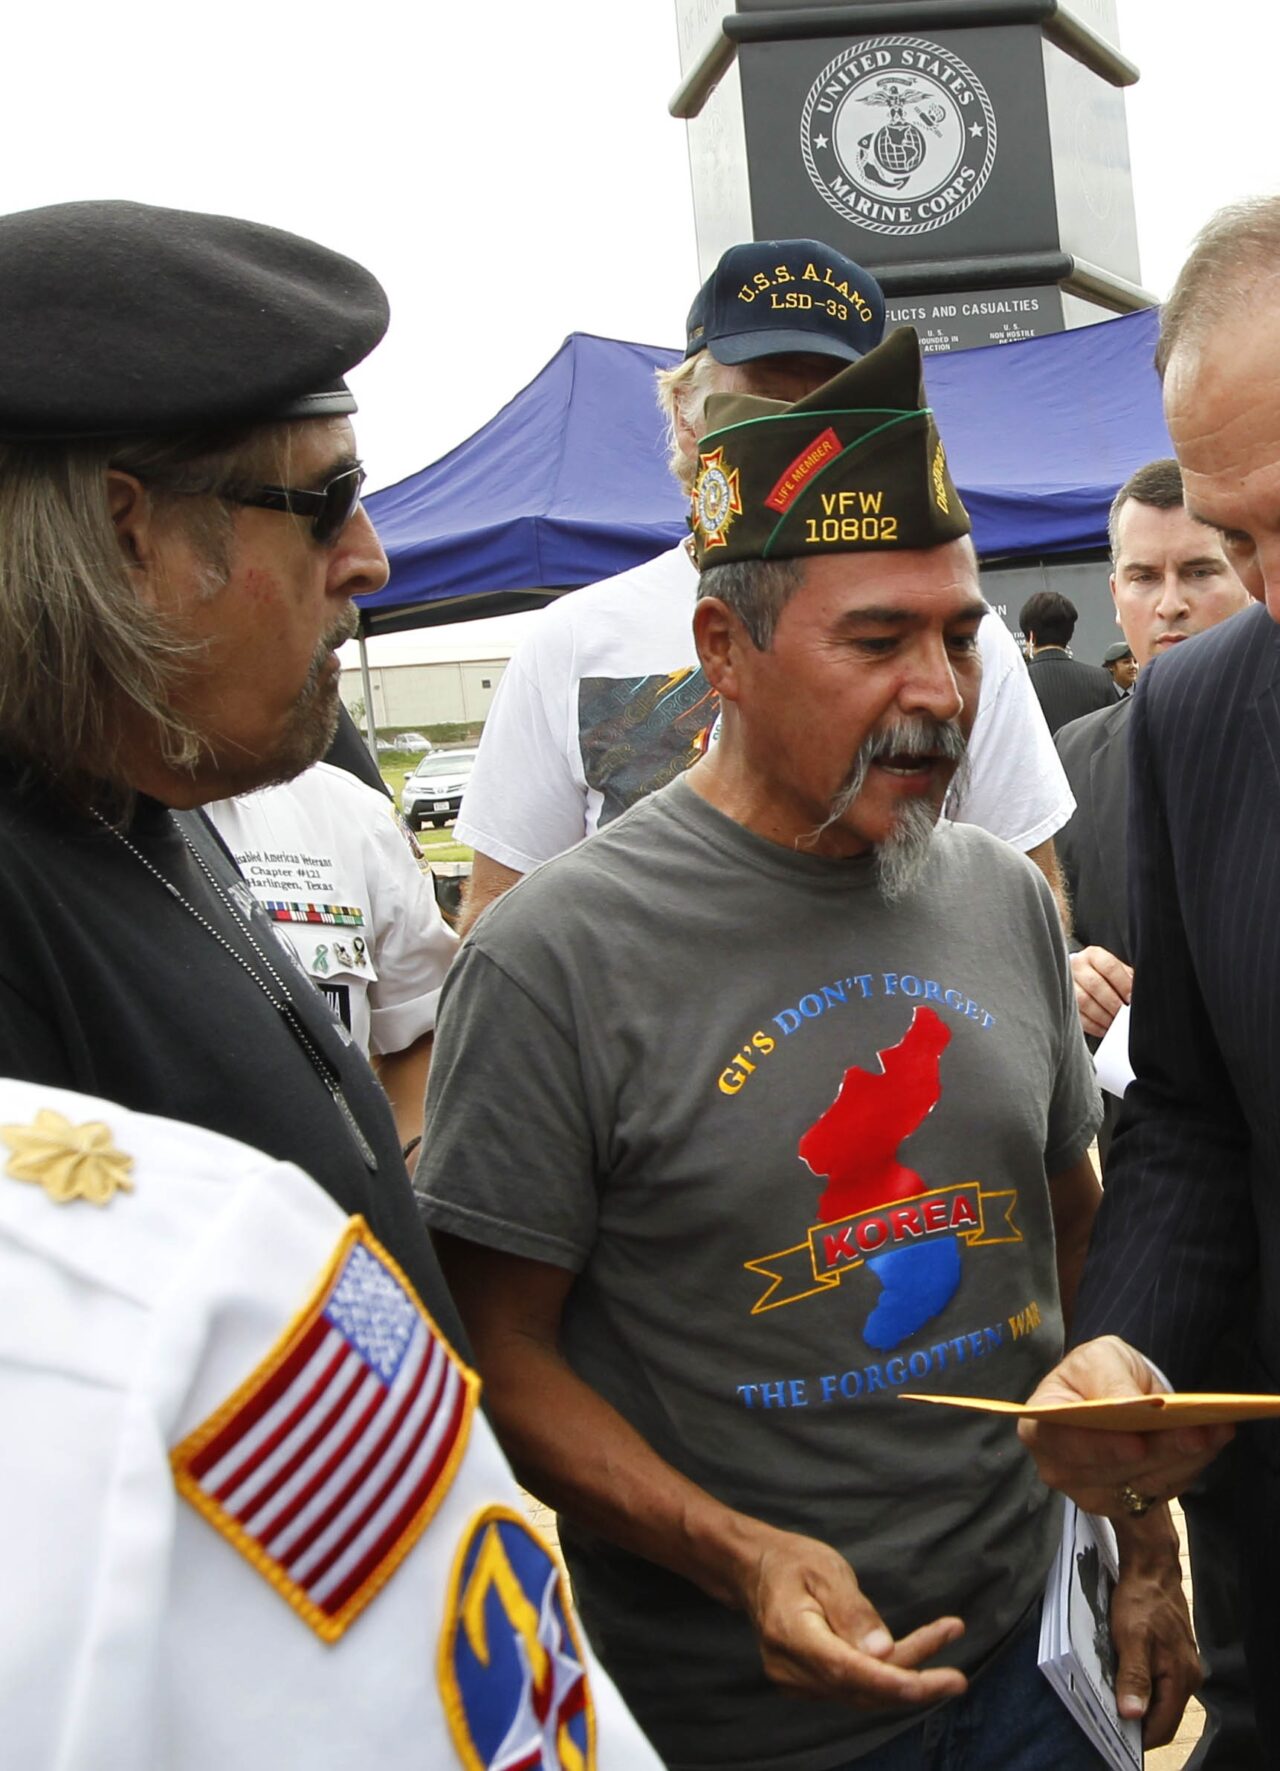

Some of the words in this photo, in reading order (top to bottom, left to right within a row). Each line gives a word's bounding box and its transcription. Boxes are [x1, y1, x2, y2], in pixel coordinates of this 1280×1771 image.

[817, 50, 892, 114] UNITED
[901, 50, 975, 106] STATES
[829, 176, 913, 223] MARINE
[917, 166, 976, 218] CORPS
[738, 265, 796, 303] U.S.S.
[802, 263, 873, 323] ALAMO
[770, 293, 848, 321] LSD-33
[932, 305, 957, 318] AND
[962, 299, 1040, 316] CASUALTIES
[919, 337, 949, 345] OUNDED
[1006, 329, 1035, 338] HOSTILE
[924, 344, 951, 352] ACTION
[774, 482, 794, 505] LIFE
[790, 440, 833, 487] MEMBER
[821, 491, 883, 516] VFW
[805, 517, 898, 543] 10802
[250, 866, 293, 877] Chapter
[297, 869, 321, 878] #121
[264, 851, 301, 864] American
[300, 854, 332, 867] Veterans
[304, 880, 334, 891] Texas
[718, 1030, 777, 1095] GI'S
[772, 973, 873, 1036] DON'T
[883, 972, 997, 1031] FORGET
[822, 1195, 979, 1268] KOREA
[737, 1379, 810, 1409] THE
[820, 1322, 1004, 1404] FORGOTTEN
[1007, 1301, 1042, 1341] WAR
